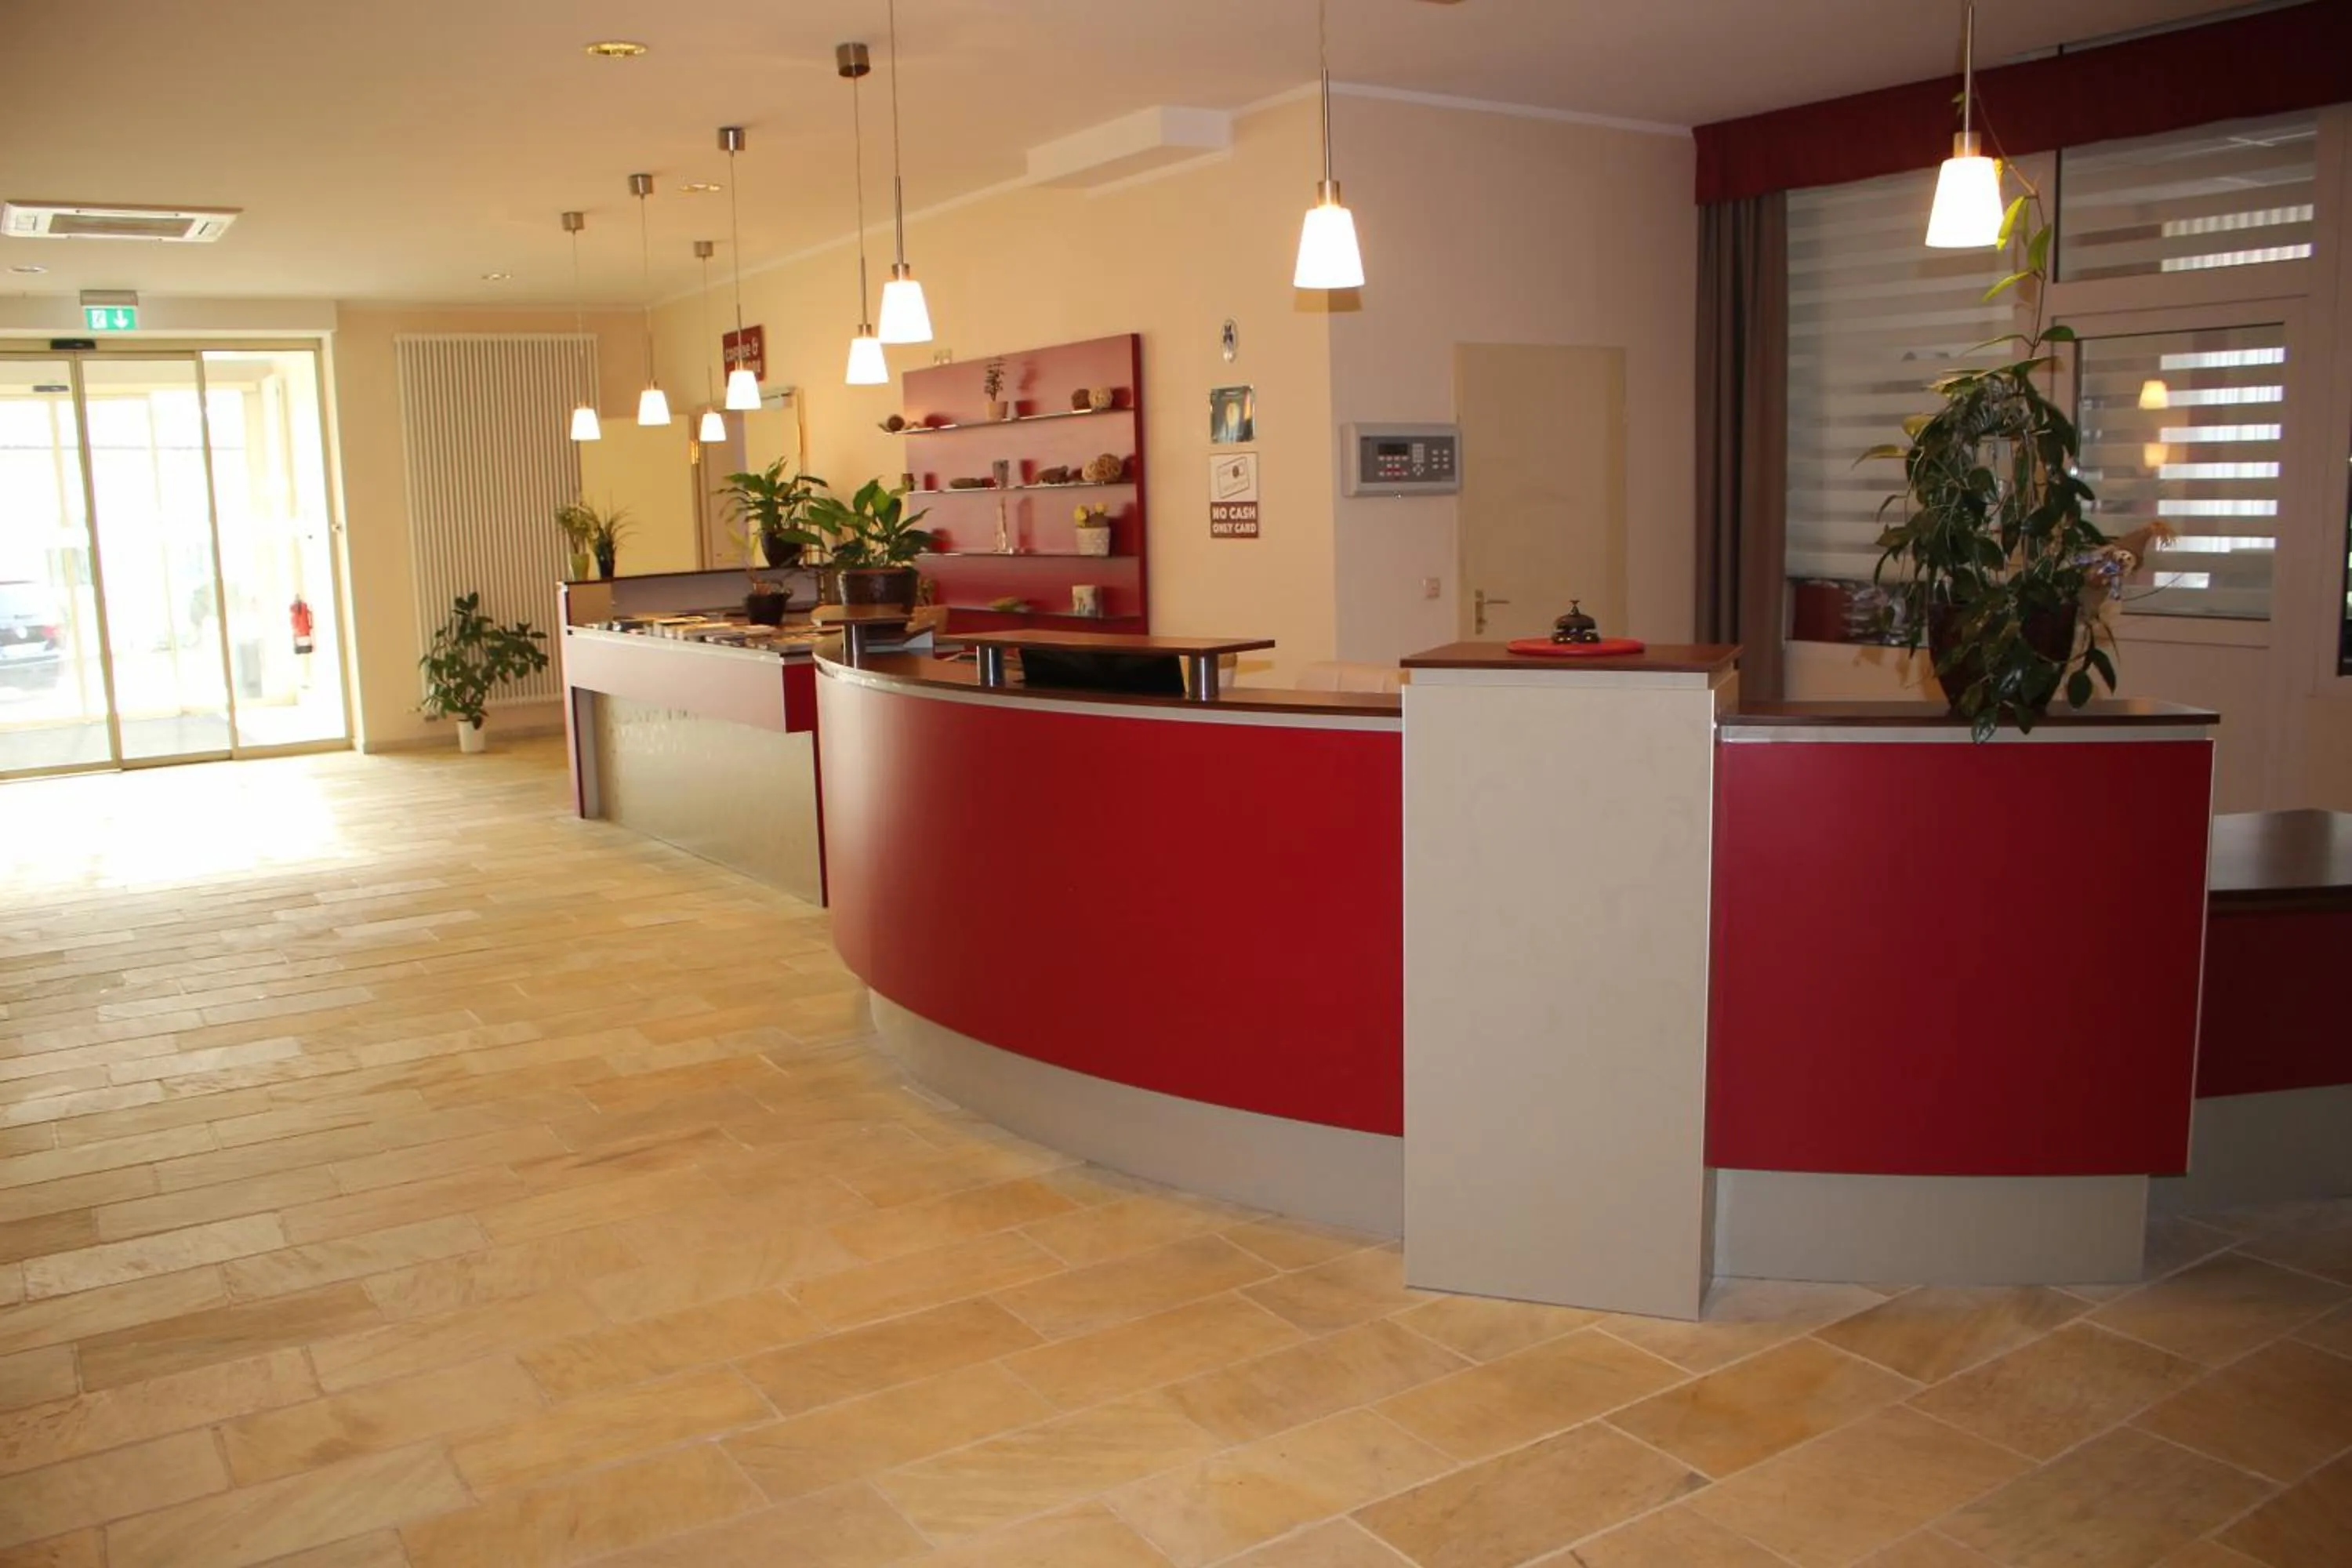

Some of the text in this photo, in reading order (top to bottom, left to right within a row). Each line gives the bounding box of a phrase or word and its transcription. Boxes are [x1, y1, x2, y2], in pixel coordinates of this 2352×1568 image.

[1213, 506, 1256, 520] NO CASH
[1213, 523, 1256, 533] ONLY CARD
